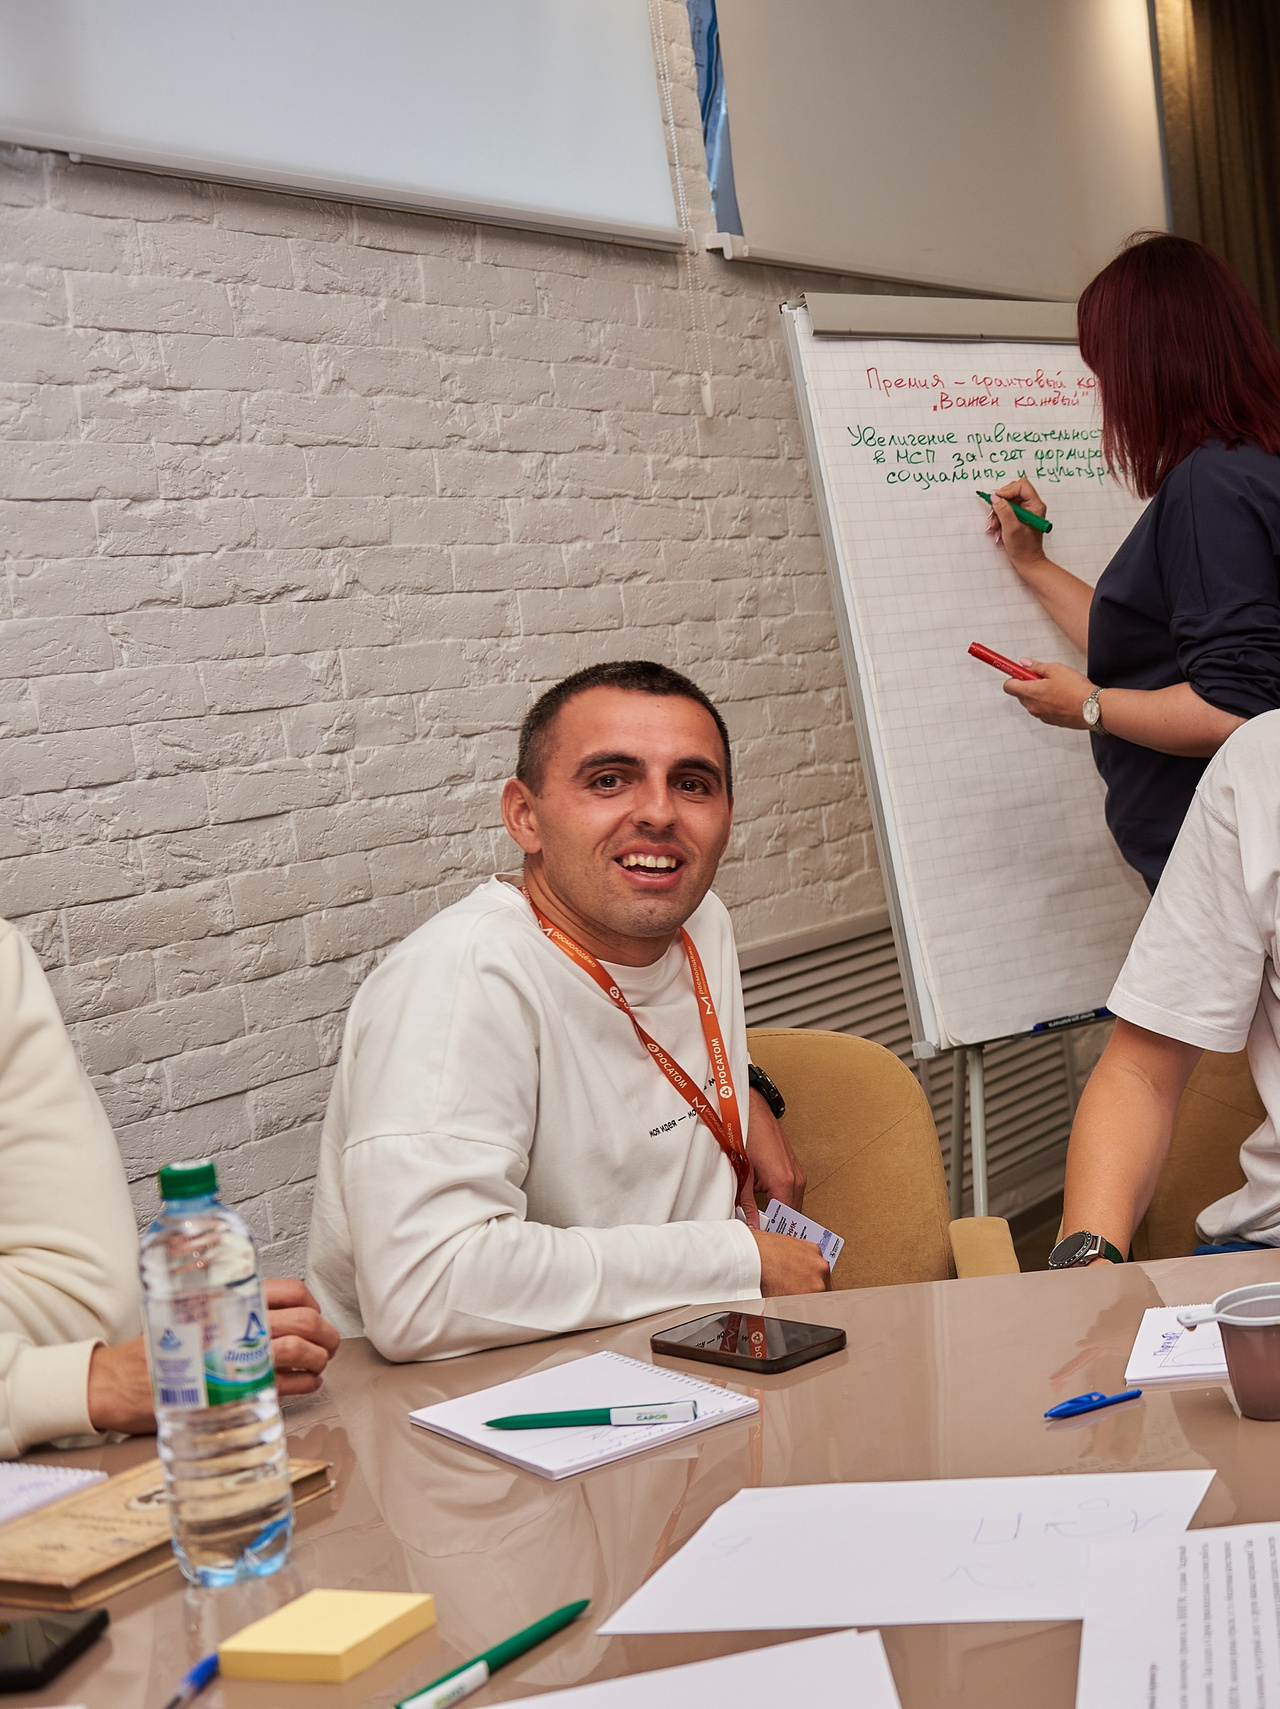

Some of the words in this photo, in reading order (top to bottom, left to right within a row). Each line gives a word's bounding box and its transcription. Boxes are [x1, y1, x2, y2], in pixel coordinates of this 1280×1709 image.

[866, 367, 945, 397] Премия
[972, 368, 1066, 397] грантовый
[847, 425, 958, 447] Увеличение
[873, 449, 886, 464] в
[897, 449, 935, 464] МСП
[952, 452, 977, 468] за
[887, 467, 1006, 491] социальных
[1017, 469, 1026, 478] и
[655, 1052, 688, 1089] РОСАТОМ
[711, 1038, 728, 1085] РОСАТОМ
[649, 1127, 661, 1138] моя
[660, 1120, 677, 1133] идея
